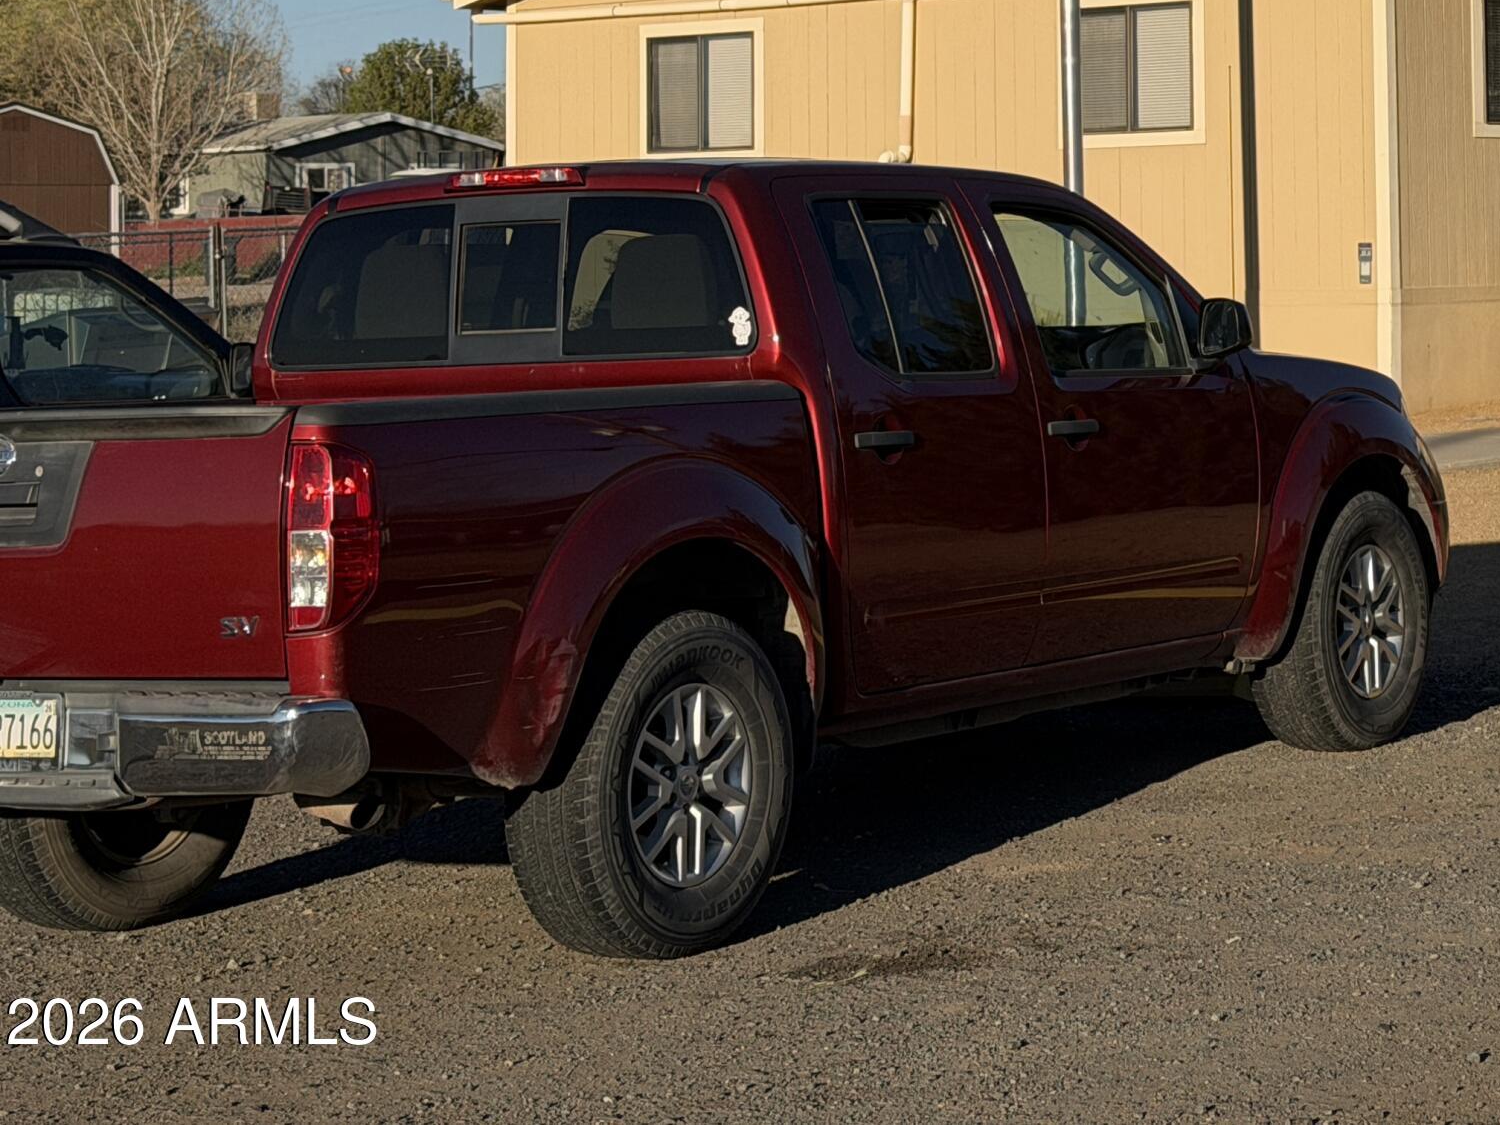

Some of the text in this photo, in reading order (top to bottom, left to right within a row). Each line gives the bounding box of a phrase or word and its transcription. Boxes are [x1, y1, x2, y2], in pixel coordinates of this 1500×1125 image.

[219, 616, 260, 639] SV
[0, 713, 54, 750] 7166
[203, 730, 266, 745] SCOTLAND
